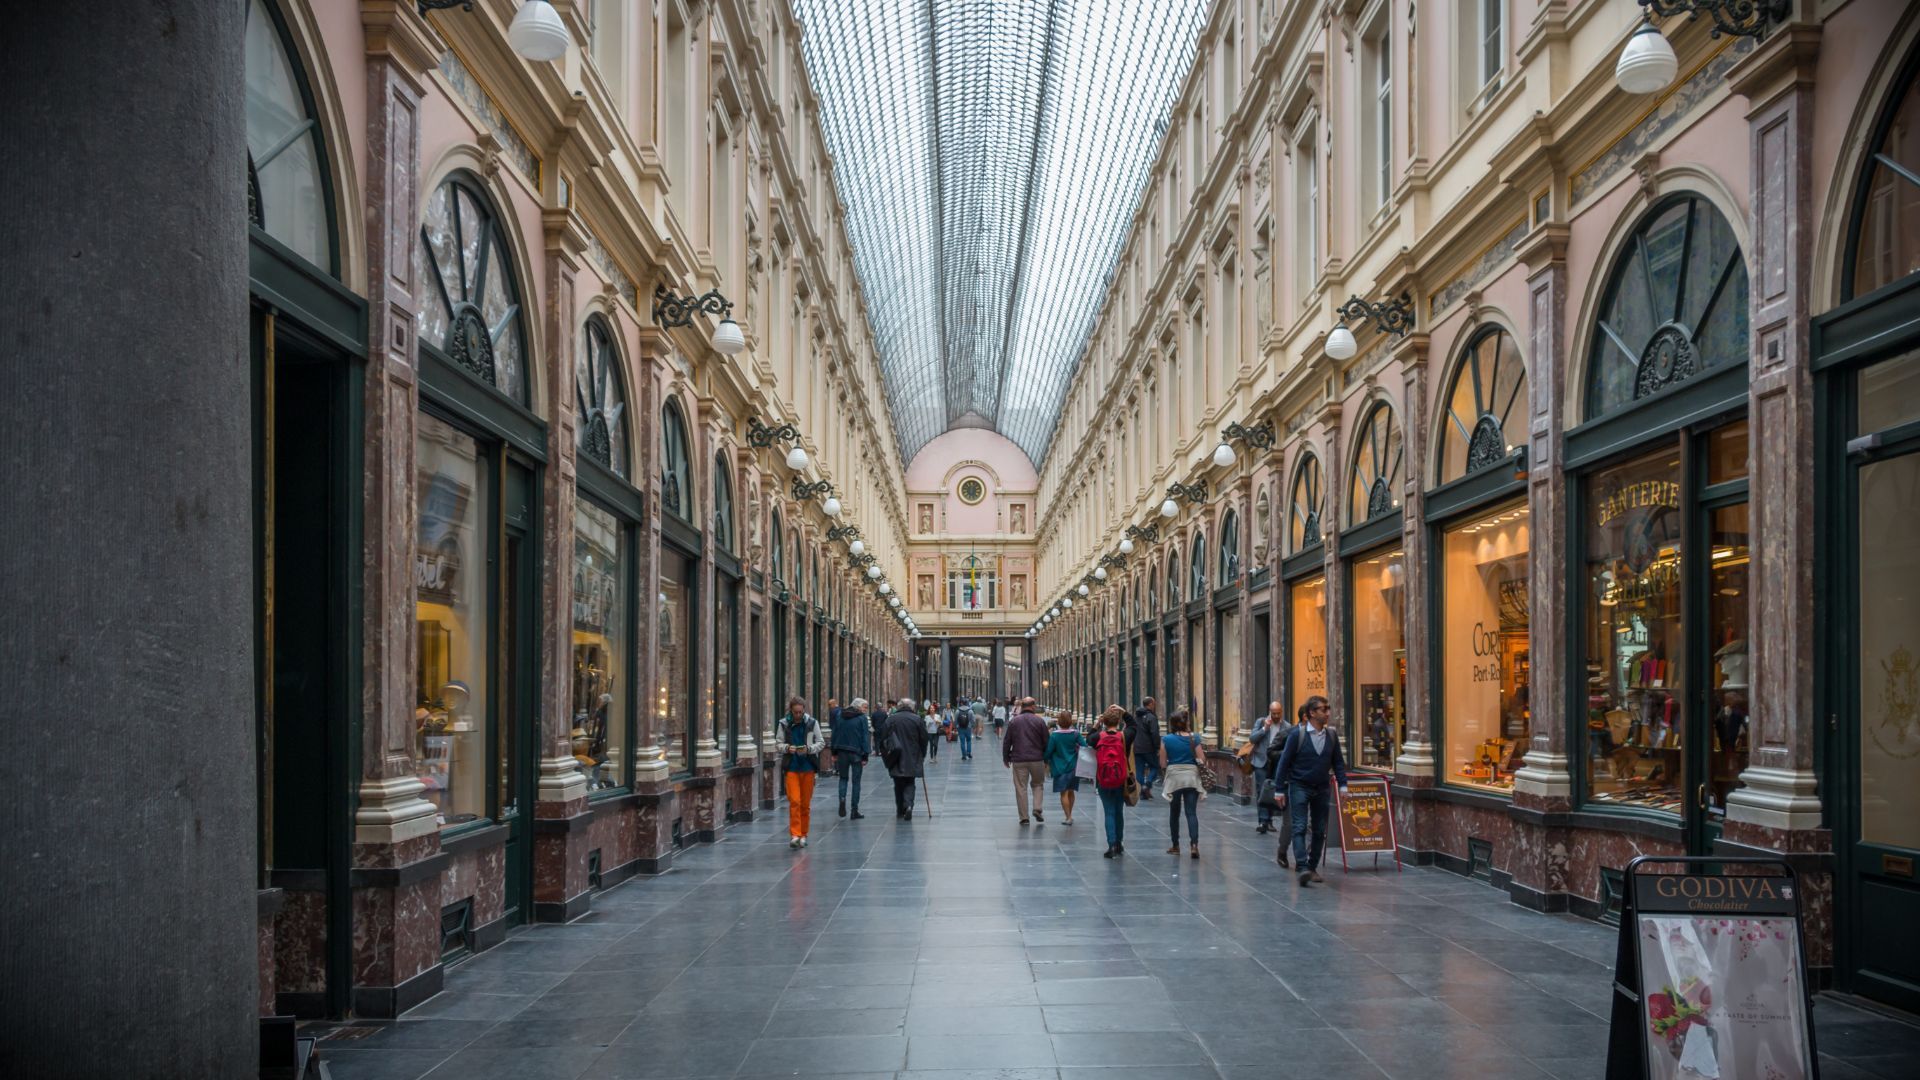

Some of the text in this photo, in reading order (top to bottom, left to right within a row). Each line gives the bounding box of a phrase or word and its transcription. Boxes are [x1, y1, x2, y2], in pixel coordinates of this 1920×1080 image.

[1598, 480, 1681, 526] GANTERIE
[1657, 876, 1776, 898] GODIVA
[1688, 899, 1749, 910] Chocolatier
